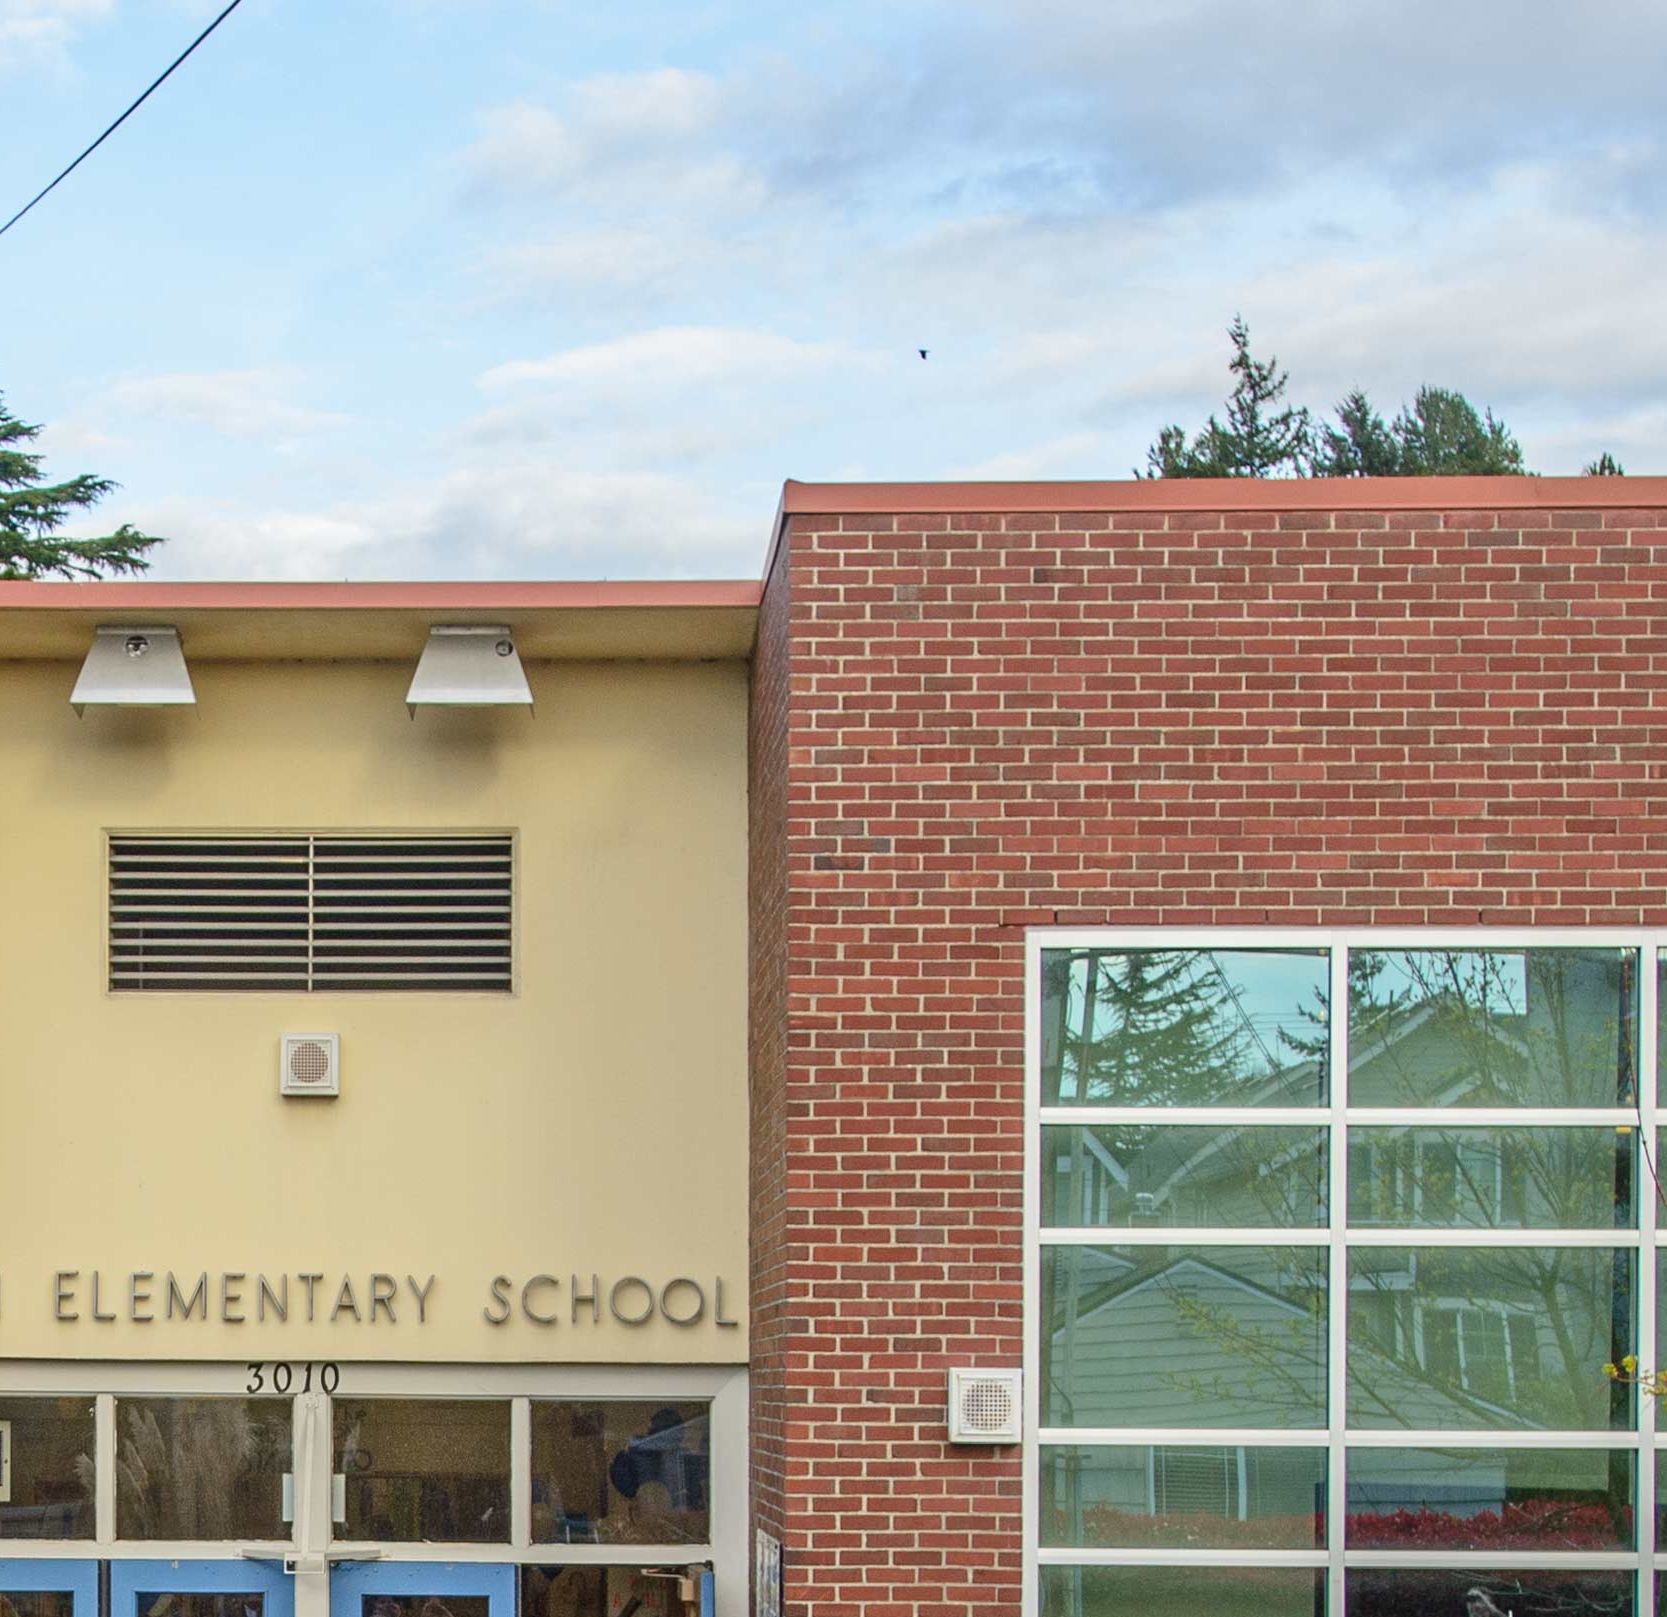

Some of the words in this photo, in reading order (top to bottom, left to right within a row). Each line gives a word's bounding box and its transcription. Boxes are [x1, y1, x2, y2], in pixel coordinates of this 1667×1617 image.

[53, 1270, 437, 1325] ELEMENTARY
[483, 1276, 740, 1328] SCHOOL
[246, 1362, 339, 1393] 3010
